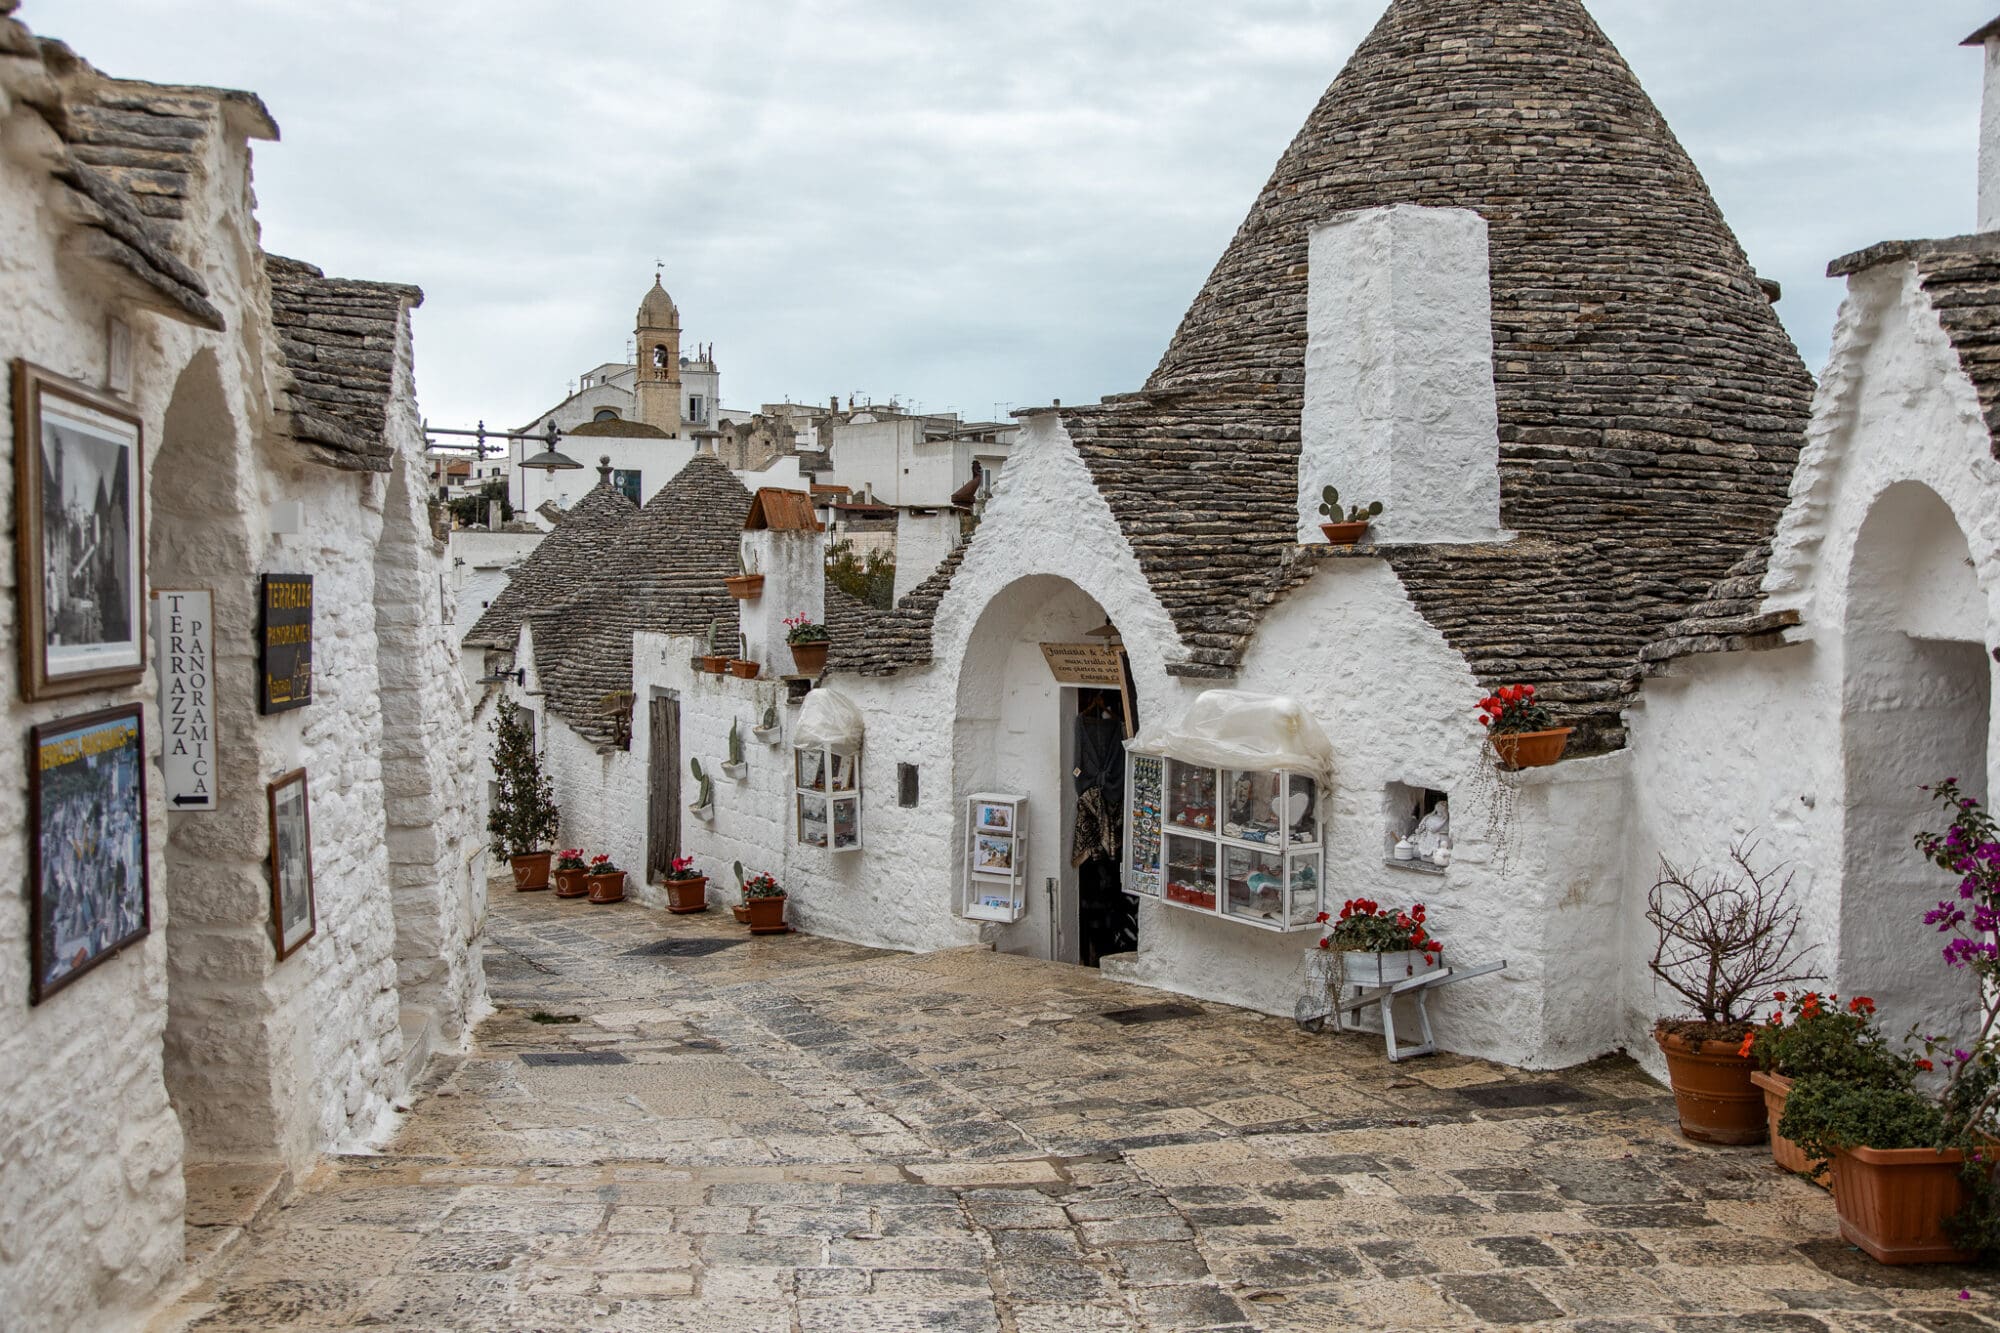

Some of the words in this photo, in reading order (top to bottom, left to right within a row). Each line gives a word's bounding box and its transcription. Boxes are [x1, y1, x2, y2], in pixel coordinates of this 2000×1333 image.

[267, 583, 311, 609] TERRAZZA
[267, 624, 311, 647] PANORAMICA
[168, 595, 188, 755] TERRAZZA
[190, 621, 208, 793] PANORAMICA
[592, 882, 602, 898] 2
